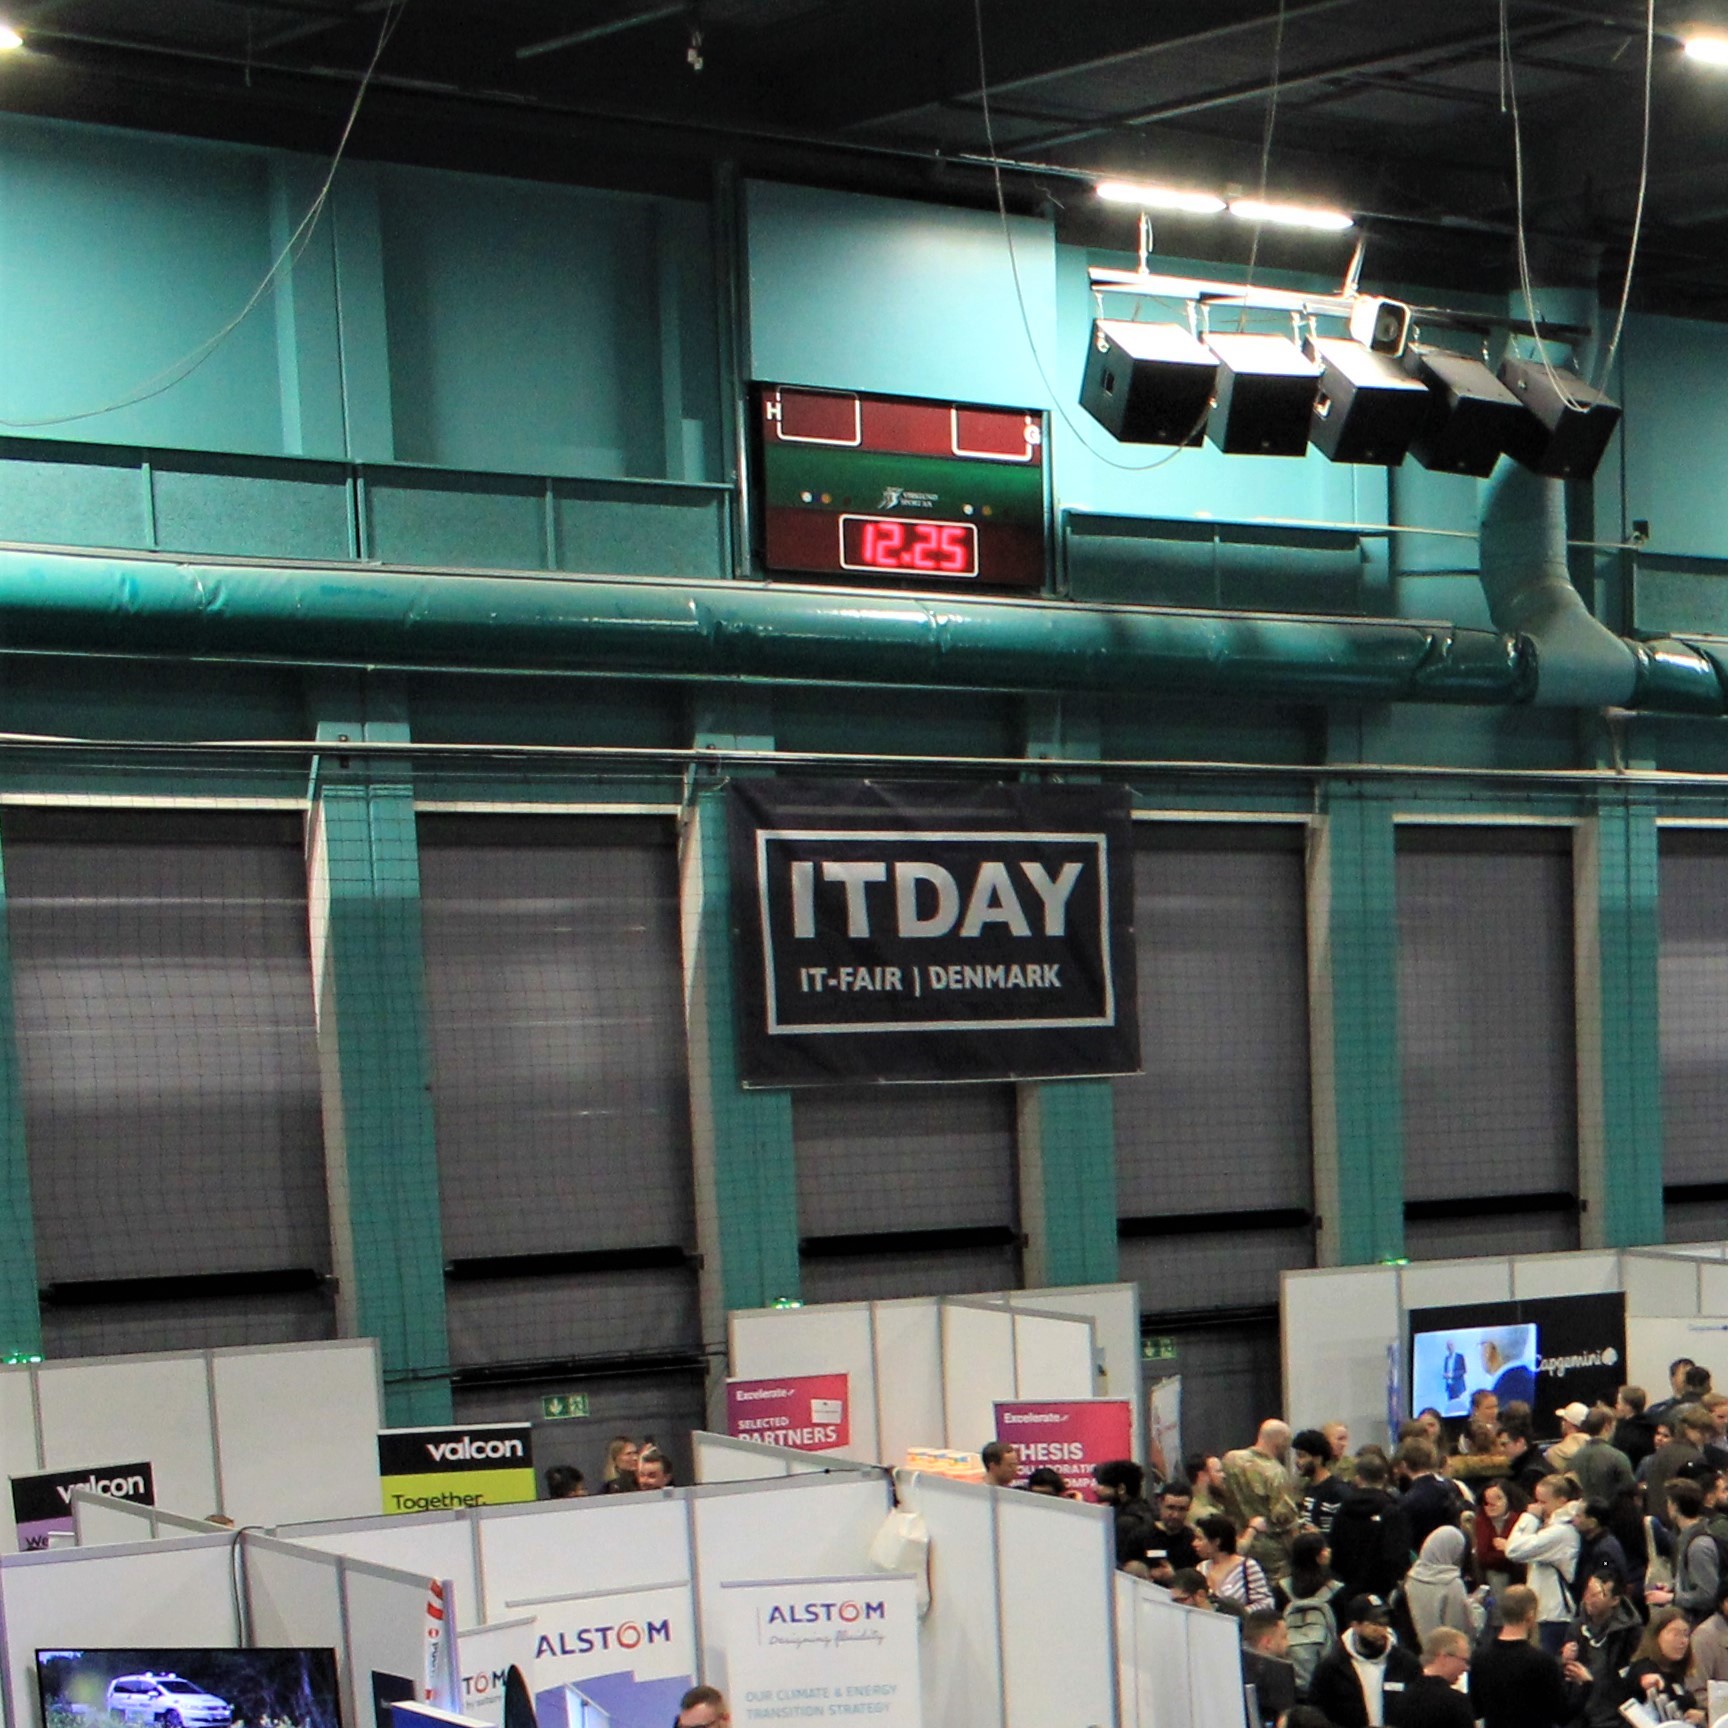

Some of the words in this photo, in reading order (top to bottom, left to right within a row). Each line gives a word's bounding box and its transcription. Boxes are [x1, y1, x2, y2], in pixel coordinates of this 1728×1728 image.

[766, 401, 781, 421] H
[1024, 425, 1040, 445] G
[791, 861, 1084, 938] ITDAY
[801, 966, 903, 991] IT-FAIR
[929, 964, 1061, 990] DENMARK
[738, 1416, 790, 1429] SELECTED
[1004, 1412, 1060, 1425] Excelerate
[426, 1436, 523, 1461] valcon
[392, 1491, 486, 1511] Together.
[768, 1600, 885, 1623] ALSTOM
[535, 1617, 671, 1659] ALSTOM
[776, 1687, 829, 1701] CLIMATE
[846, 1684, 898, 1697] ENERGY
[829, 1701, 891, 1715] STRATEGY
